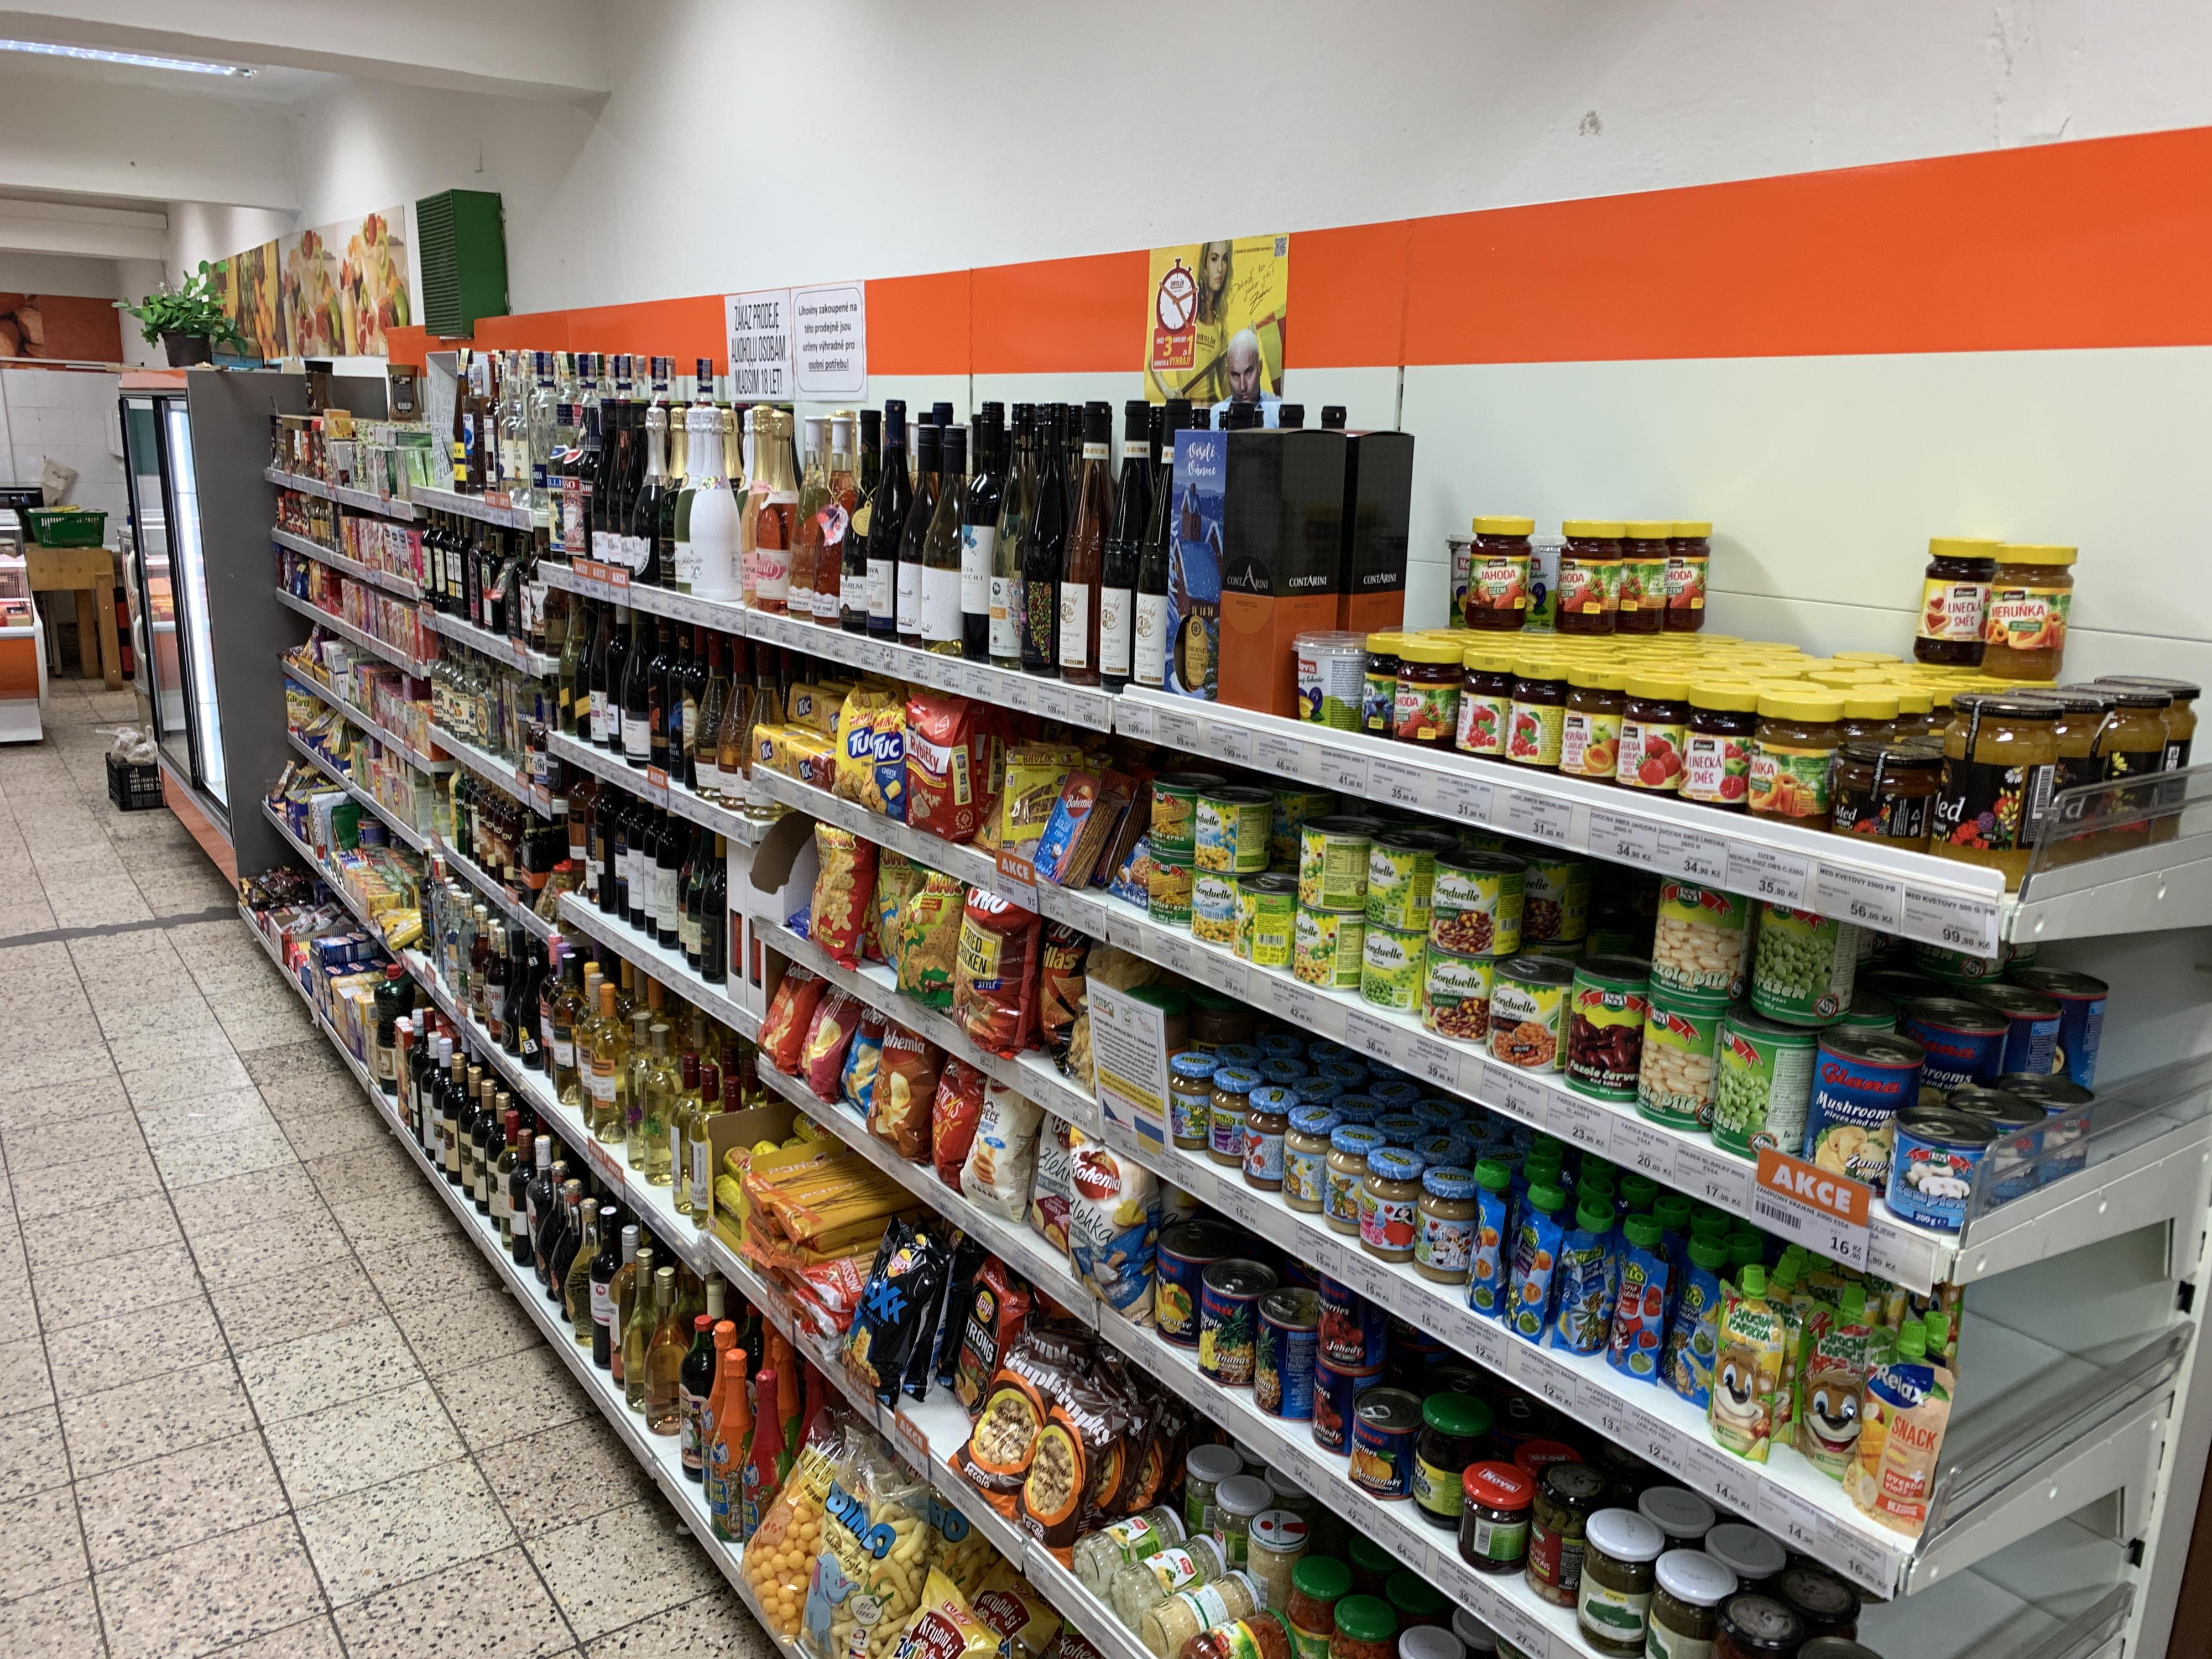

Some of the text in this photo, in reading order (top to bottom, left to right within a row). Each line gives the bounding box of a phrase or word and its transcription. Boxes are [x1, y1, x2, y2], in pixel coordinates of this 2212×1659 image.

[734, 299, 779, 331] ZÁKAZ PRODEJE
[799, 305, 817, 316] Lihoviny
[819, 302, 848, 315] zakoupené
[805, 322, 851, 335] této prodejně jsou
[732, 332, 785, 363] ALKOHOLU OSOBÁM
[803, 340, 854, 354] určeny výhradně pro
[1162, 336, 1172, 357] 3
[1186, 334, 1193, 355] 1
[808, 358, 849, 371] osobní potřebu!
[735, 362, 782, 394] MLADŠÍM 18 LET!
[1227, 564, 1269, 591] CONTARINI
[1289, 575, 1327, 587] CONTARINI
[1363, 571, 1397, 586] CONTARINI
[1479, 570, 1516, 581] JAHODA
[1559, 572, 1584, 584] AHODA
[1948, 599, 1982, 614] LINECKÁ
[1991, 601, 2044, 618] MERUŇKA
[1954, 615, 1975, 627] SMĚS
[798, 701, 811, 713] TUC
[1394, 697, 1419, 707] AHODA
[761, 744, 772, 759] TUC
[874, 733, 900, 758] TUC
[910, 739, 940, 773] Rybičky
[1689, 755, 1723, 769] LINECKÁ
[800, 763, 812, 778] TUC
[882, 768, 896, 776] CHEESE
[1694, 771, 1714, 784] SMĚS
[1065, 795, 1093, 809] Bohemia
[1835, 804, 1857, 821] Med
[1001, 862, 1029, 881] AKCE
[1711, 868, 1721, 878] Kč
[1820, 868, 1834, 877] MED
[1835, 873, 1866, 885] KVETOVY
[1196, 885, 1232, 901] Bonduelle
[1435, 881, 1480, 902] Bonduelle
[1788, 891, 1798, 900] Kč
[1906, 891, 1921, 901] MED
[1882, 915, 1893, 925] Kč
[963, 927, 983, 954] FRIED
[1978, 940, 1991, 950] Kč
[957, 944, 988, 975] CHICKEN
[977, 979, 996, 990] STYLE
[1432, 968, 1480, 989] Bonduelle
[525, 1041, 533, 1053] 3
[1569, 1061, 1600, 1078] Fazole
[1820, 1062, 1902, 1094] Giana
[937, 1083, 964, 1119] STICKS
[1816, 1091, 1897, 1120] Mushrooms
[1850, 1118, 1869, 1128] and
[1071, 1163, 1121, 1191] Bohemia
[1772, 1164, 1852, 1214] AKCE
[1731, 1197, 1741, 1208] Kč
[1833, 1218, 1849, 1230] ESSA
[1829, 1236, 1849, 1255] 16
[966, 1318, 994, 1363] TRONG
[1327, 1340, 1363, 1356] Jahody
[1877, 1363, 1926, 1407] Relax
[900, 1418, 924, 1448] AKCE
[1313, 1420, 1342, 1440] Jahody
[1891, 1415, 1938, 1452] SNACK
[1355, 1466, 1402, 1488] Mandarinky
[1885, 1473, 1924, 1490] ovesné
